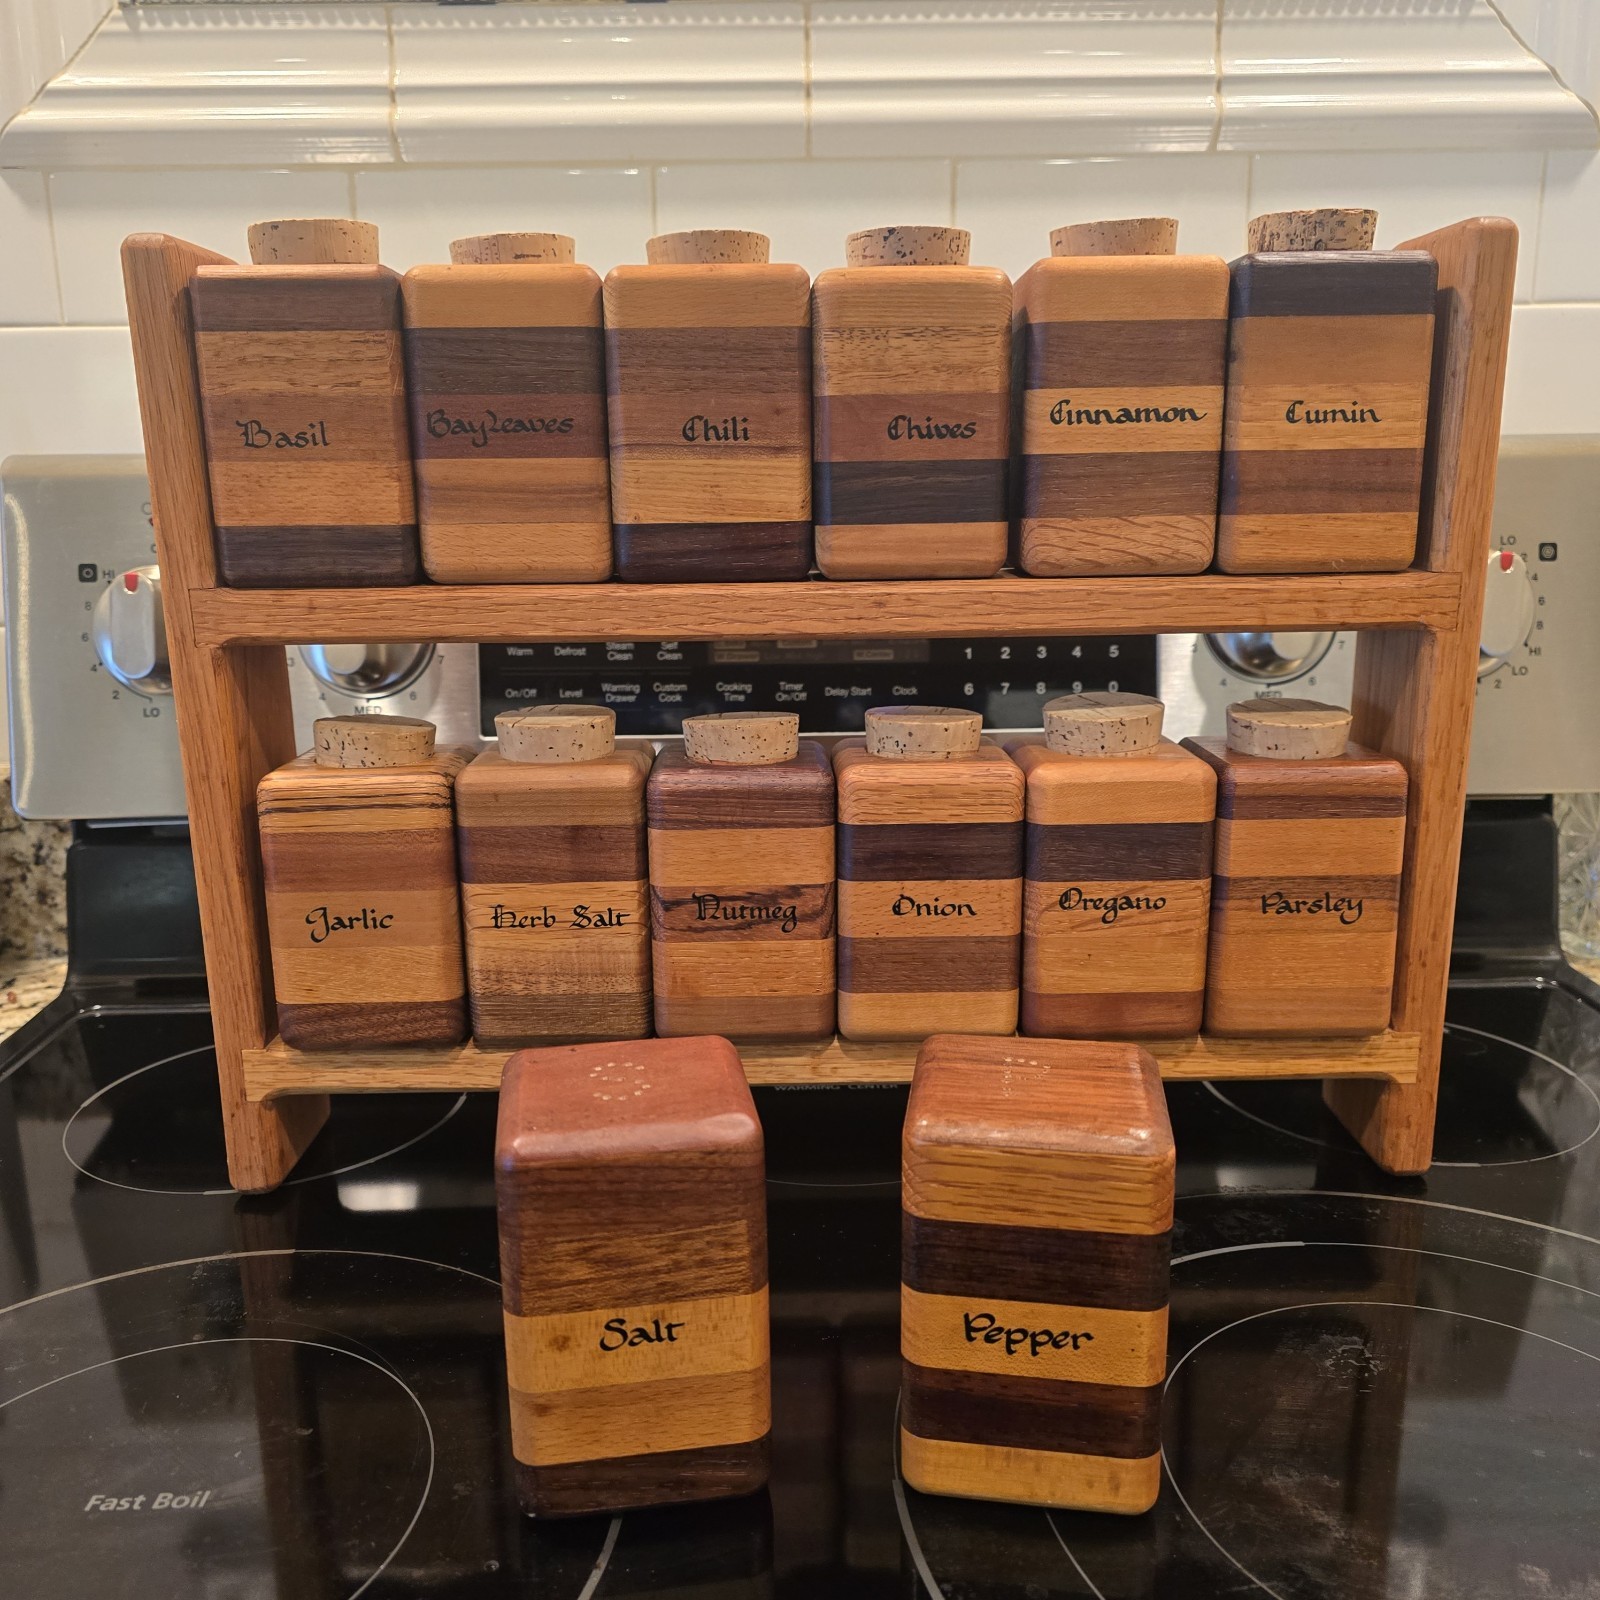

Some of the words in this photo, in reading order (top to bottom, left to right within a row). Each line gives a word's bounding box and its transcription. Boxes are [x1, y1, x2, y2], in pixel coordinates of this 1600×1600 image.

[1049, 399, 1208, 426] Cinnamon
[1285, 400, 1383, 424] Cumin
[236, 419, 332, 449] Basil
[682, 415, 750, 442] Chili
[887, 414, 978, 441] Chives
[507, 646, 534, 657] Warm
[554, 646, 587, 657] Defrost
[607, 651, 634, 662] Clean
[656, 651, 683, 662] Clean
[964, 648, 973, 660] 1
[1000, 647, 1011, 659] 2
[1036, 646, 1048, 659] 3
[1071, 645, 1082, 658] 4
[1108, 645, 1120, 658] 5
[601, 682, 641, 694] Warming
[653, 682, 688, 693] Custom
[716, 681, 752, 693] Cooking
[779, 681, 803, 692] Timer
[892, 686, 918, 696] Clock
[963, 683, 974, 695] 6
[1001, 682, 1010, 695] 7
[1035, 682, 1047, 695] 8
[1071, 681, 1083, 693] 9
[1108, 680, 1119, 693] 0
[112, 690, 120, 700] 2
[559, 688, 583, 699] Level
[605, 692, 637, 703] Drawer
[658, 692, 682, 703] Cook
[724, 692, 745, 703] Time
[143, 708, 160, 718] LO
[891, 893, 977, 917] Onion
[1058, 887, 1167, 924] Oregano
[1260, 891, 1363, 925] Parsley
[490, 904, 556, 930] Herb
[568, 904, 631, 929] Salt
[692, 892, 797, 933] Nutmeg
[305, 906, 394, 943] Garlic
[599, 1318, 685, 1352] Salt
[963, 1312, 1095, 1357] Pepper
[84, 1494, 147, 1512] Fast
[151, 1490, 211, 1510] Boil
